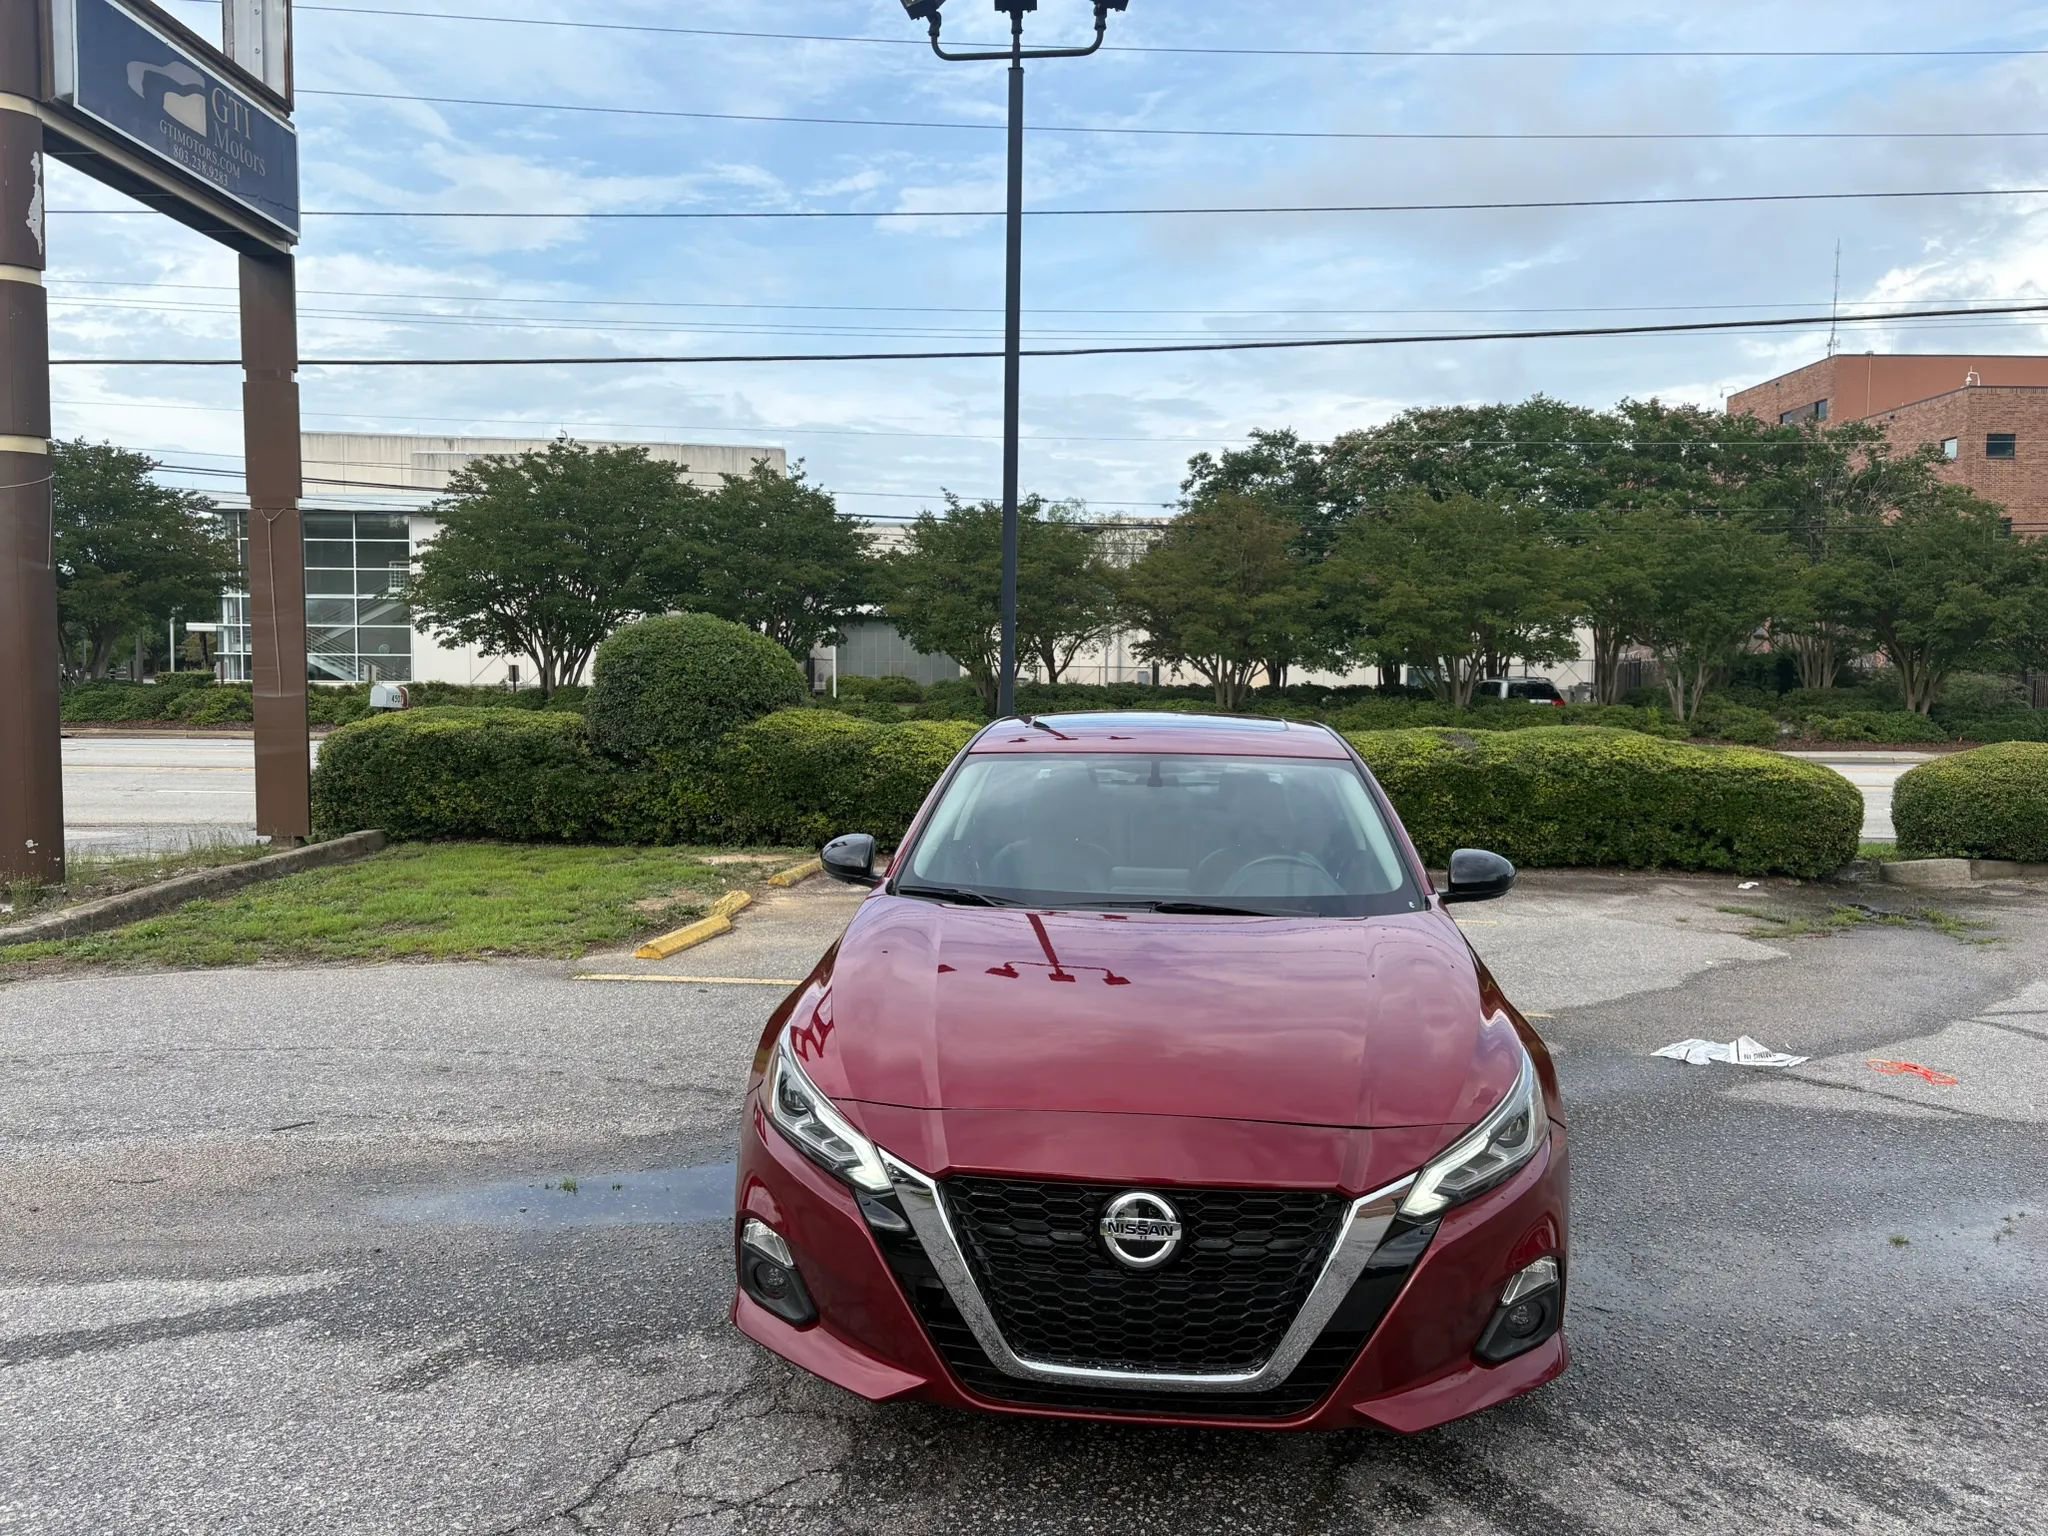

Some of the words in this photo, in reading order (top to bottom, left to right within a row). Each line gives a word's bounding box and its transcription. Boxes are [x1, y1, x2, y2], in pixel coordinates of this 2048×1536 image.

[212, 87, 251, 140] GTI
[159, 119, 240, 179] GTIMOTORS.COM
[173, 144, 229, 186] 803.238.9283
[214, 121, 266, 176] Motors
[1107, 1222, 1174, 1237] NISSAN
